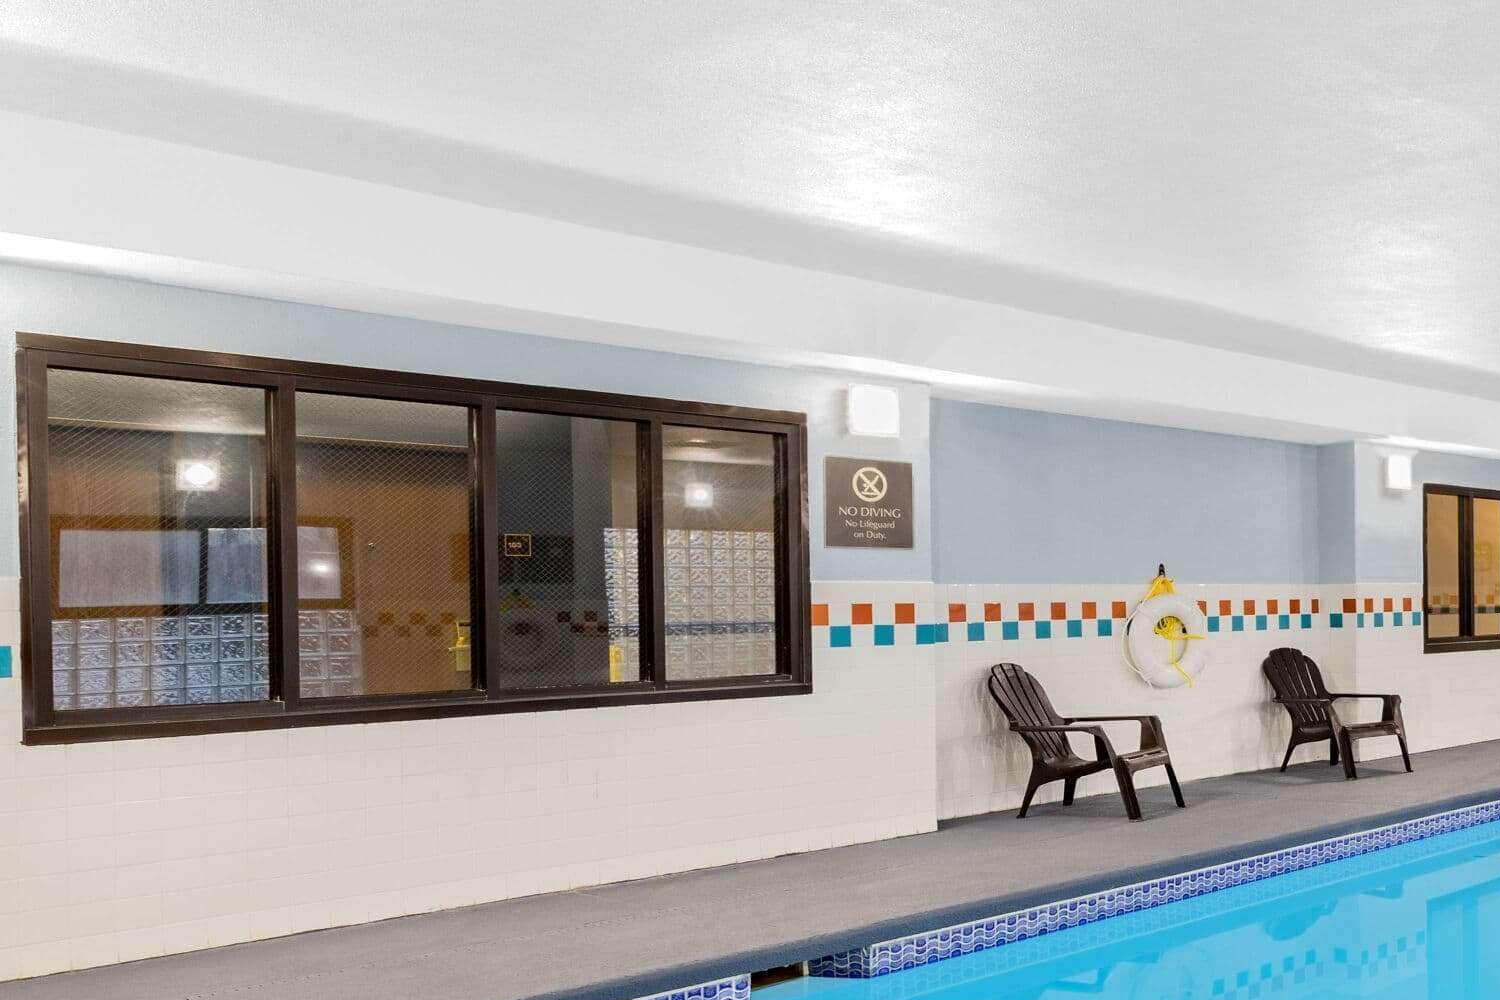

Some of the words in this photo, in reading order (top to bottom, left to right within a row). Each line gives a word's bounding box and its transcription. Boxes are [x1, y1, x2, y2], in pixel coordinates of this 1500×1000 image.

[839, 506, 858, 516] NO
[860, 507, 901, 519] DIVING
[845, 519, 858, 527] No
[859, 520, 895, 530] Lifeguard
